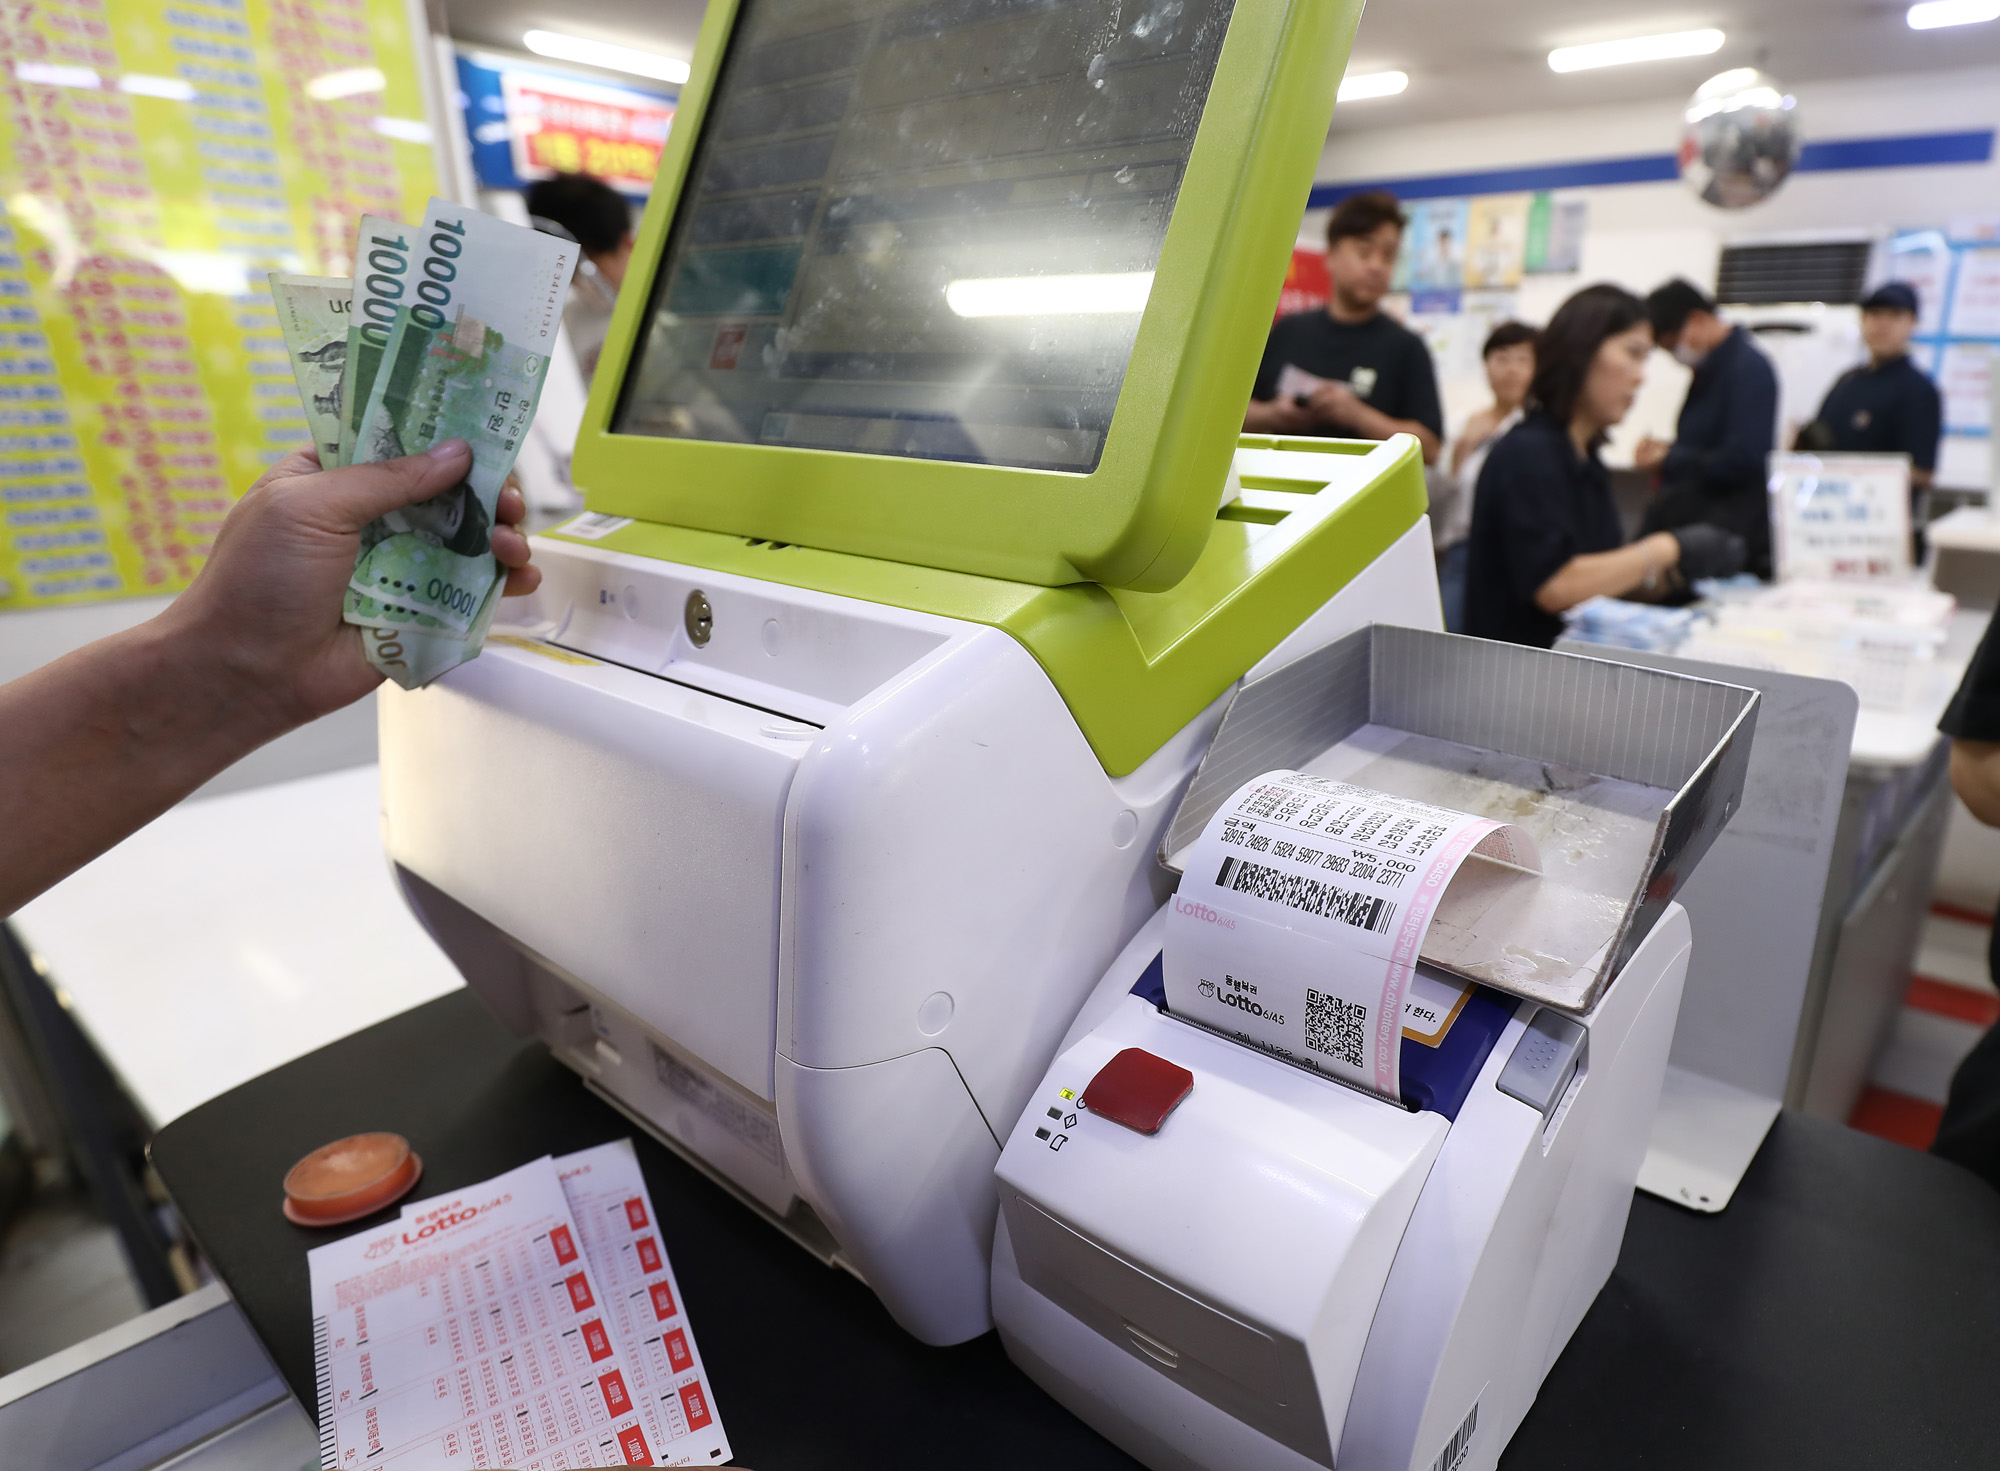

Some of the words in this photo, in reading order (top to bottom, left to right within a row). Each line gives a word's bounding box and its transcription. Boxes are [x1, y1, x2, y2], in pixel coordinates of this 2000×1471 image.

[411, 220, 466, 329] 10000
[556, 254, 566, 270] KE
[361, 235, 409, 349] 10000
[427, 578, 477, 617] 10000
[1223, 819, 1257, 832] 금액
[1274, 813, 1291, 822] 01
[1299, 820, 1318, 829] 02
[1325, 826, 1344, 835] 08
[1350, 833, 1371, 842] 22
[1378, 840, 1398, 849] 23
[1406, 847, 1425, 856] 31
[1280, 808, 1298, 816] 02
[1308, 814, 1323, 822] 13
[1330, 820, 1350, 829] 23
[1357, 826, 1376, 835] 33
[1384, 834, 1403, 842] 40
[1412, 841, 1432, 850] 43
[1311, 808, 1329, 816] 03
[1362, 821, 1382, 829] 23
[1389, 827, 1408, 835] 25
[1418, 835, 1438, 843] 42
[1368, 815, 1387, 823] 23
[1395, 822, 1414, 830] 24
[1400, 817, 1420, 825] 32
[1221, 828, 1245, 846] 50915
[1245, 833, 1272, 852] 24826
[1271, 840, 1297, 859] 15824
[1295, 847, 1324, 865] 59977
[1321, 854, 1350, 873] 29683
[1349, 861, 1378, 881] 32004
[1376, 868, 1406, 889] 23771
[1175, 897, 1217, 924] Lotto
[1217, 916, 1236, 930] 6/45
[1217, 987, 1263, 1017] Lotto
[1263, 1009, 1285, 1026] 6/45
[1379, 960, 1405, 1073] www.dhlottery.co.kr
[1413, 1007, 1436, 1022] 한다.
[1261, 1040, 1293, 1056] 1122
[402, 1207, 477, 1245] Lotto
[621, 1421, 632, 1429] E
